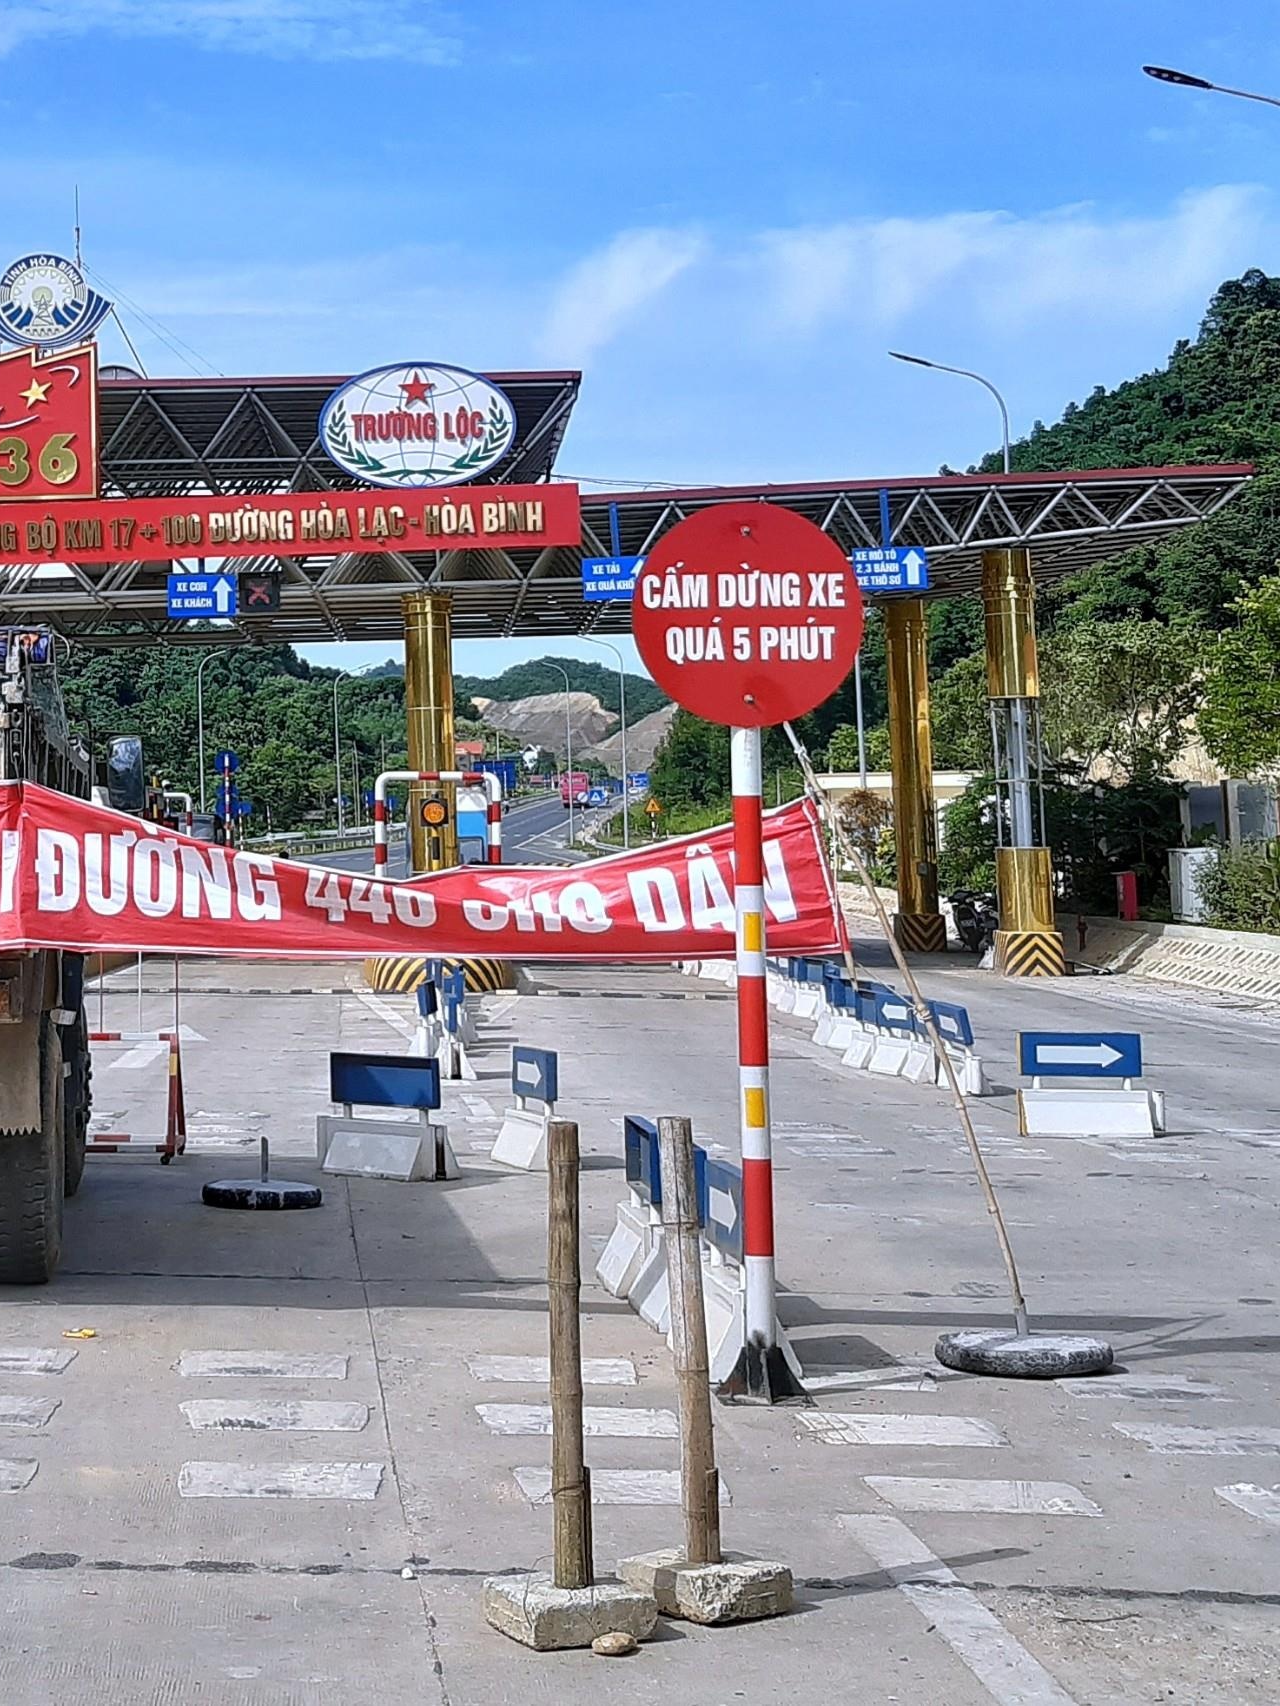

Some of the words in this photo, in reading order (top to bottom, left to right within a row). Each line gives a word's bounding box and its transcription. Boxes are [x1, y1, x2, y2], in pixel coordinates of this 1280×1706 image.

[29, 256, 56, 267] HÒA
[351, 405, 437, 442] TRƯỜNG
[444, 406, 484, 446] LỘC
[26, 513, 57, 556] BỘ
[64, 518, 101, 549] KM
[109, 518, 135, 547] 17
[161, 513, 201, 545] 100
[209, 504, 293, 542] ĐƯỜNG
[300, 501, 350, 540] HÒA
[358, 506, 405, 543] LẠC
[425, 496, 475, 535] HÒA
[482, 495, 544, 533] BÌNH
[855, 551, 867, 560] XE
[592, 564, 604, 575] XE
[177, 582, 188, 592] XE
[189, 582, 208, 592] CON
[585, 581, 597, 592] XE
[598, 578, 615, 590] QUÁ
[642, 561, 708, 608] CẤM
[718, 562, 801, 608] DỪNG
[808, 573, 845, 607] XE
[171, 598, 182, 608] XE
[184, 596, 212, 608] KHÁCH
[665, 616, 725, 664] QUÁ
[733, 627, 750, 661] 5
[759, 617, 835, 661] PHÚT
[35, 821, 282, 921] ĐƯỜNG
